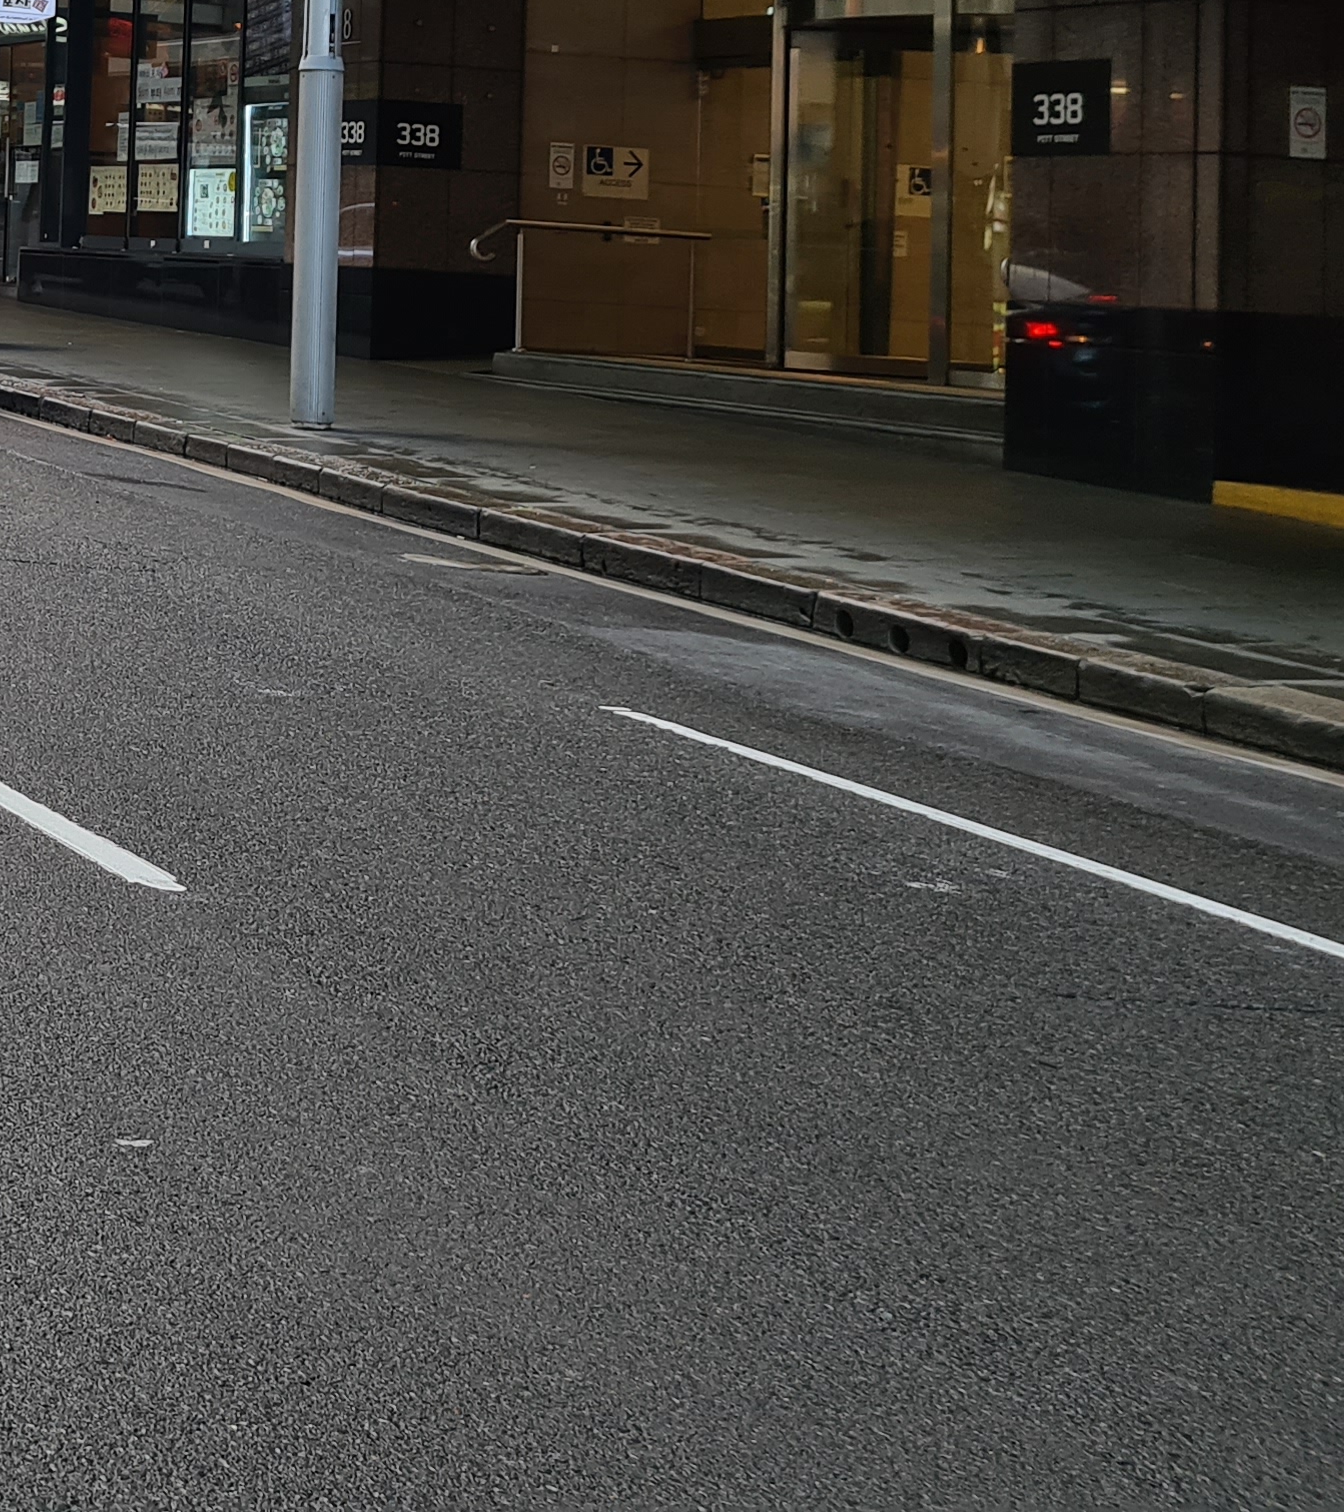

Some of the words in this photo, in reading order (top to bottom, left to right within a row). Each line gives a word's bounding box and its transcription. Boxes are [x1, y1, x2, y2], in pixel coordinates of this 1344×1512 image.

[1033, 92, 1083, 125] 338
[341, 121, 365, 144] 338
[396, 122, 440, 147] 338
